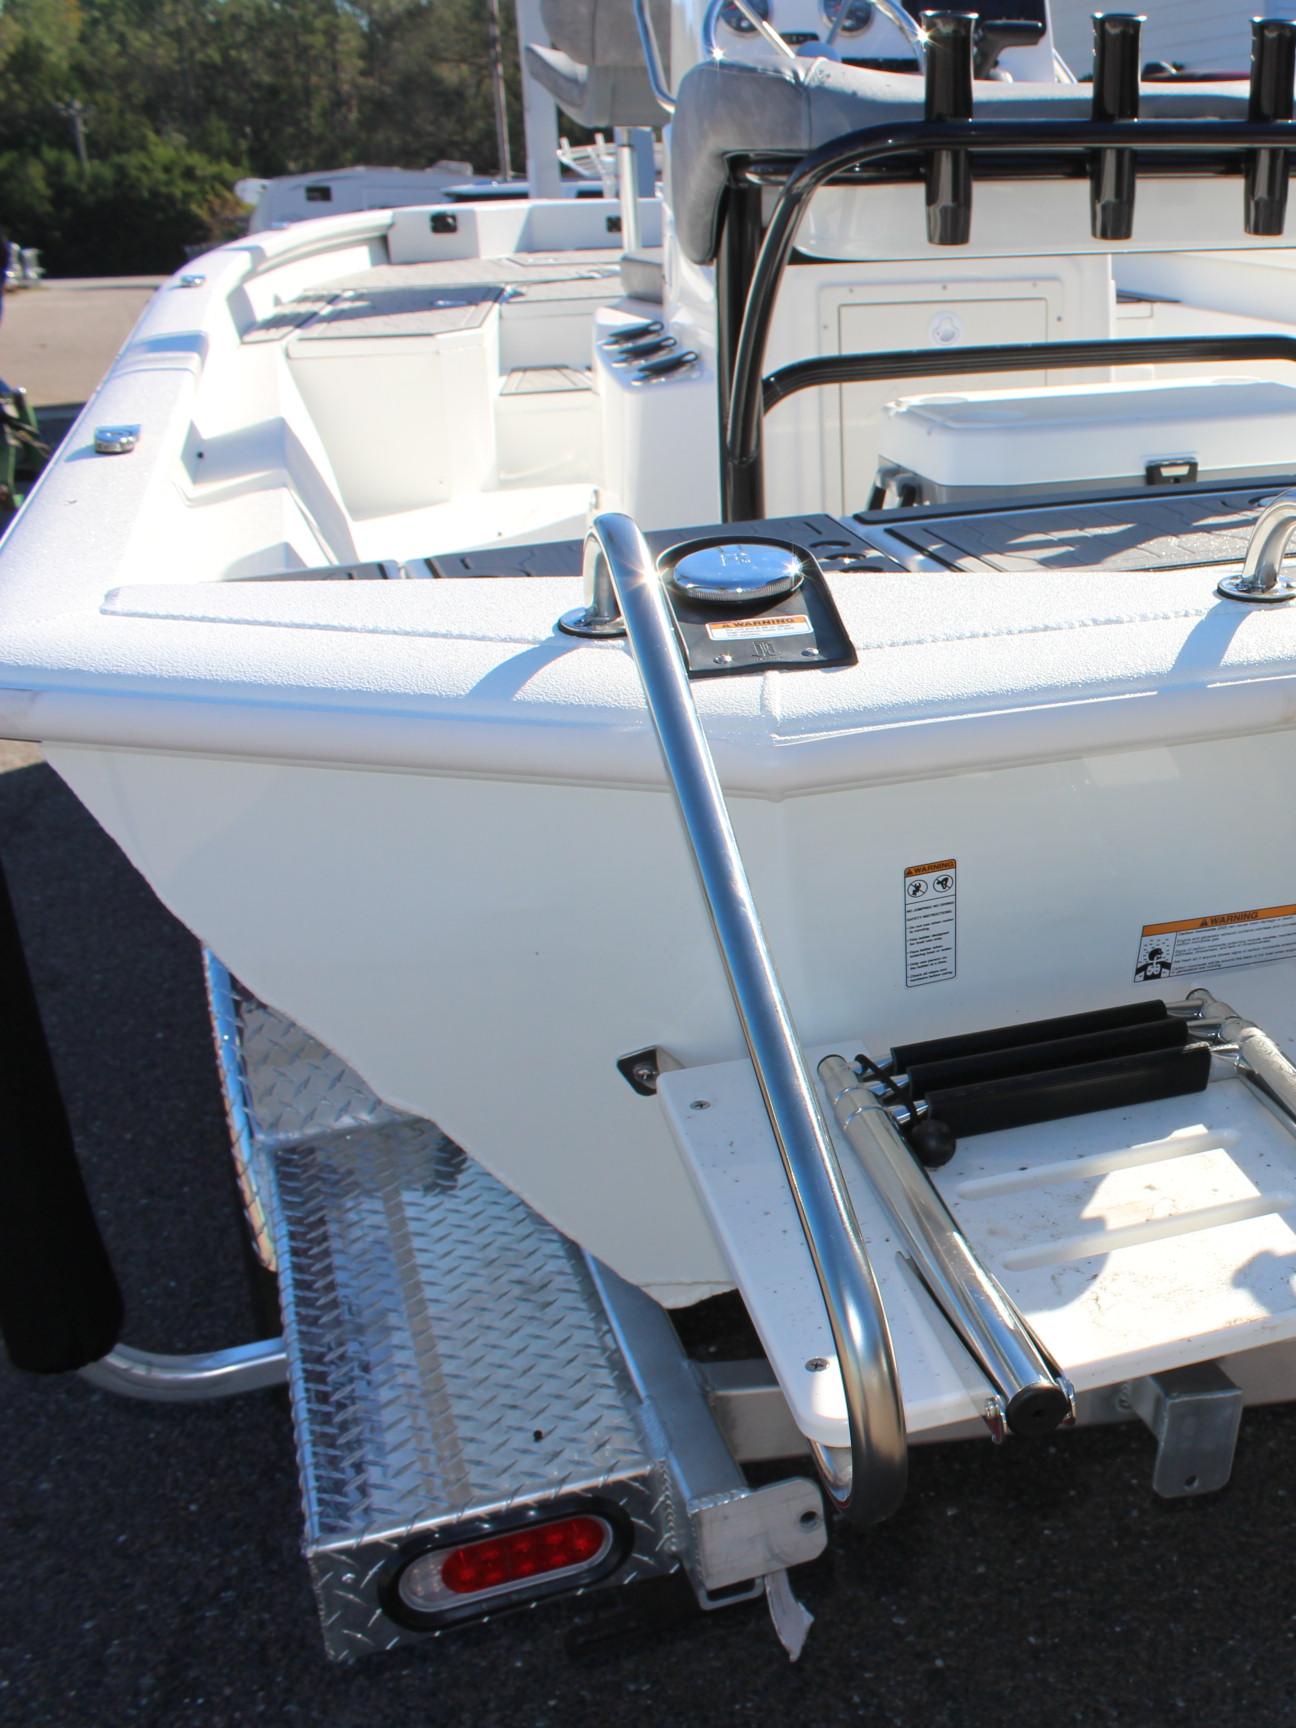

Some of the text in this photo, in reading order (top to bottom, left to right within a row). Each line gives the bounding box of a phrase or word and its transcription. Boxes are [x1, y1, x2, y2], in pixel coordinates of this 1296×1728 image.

[733, 617, 794, 628] WARNING
[914, 860, 954, 873] WARNING
[1210, 911, 1259, 926] WARNING
